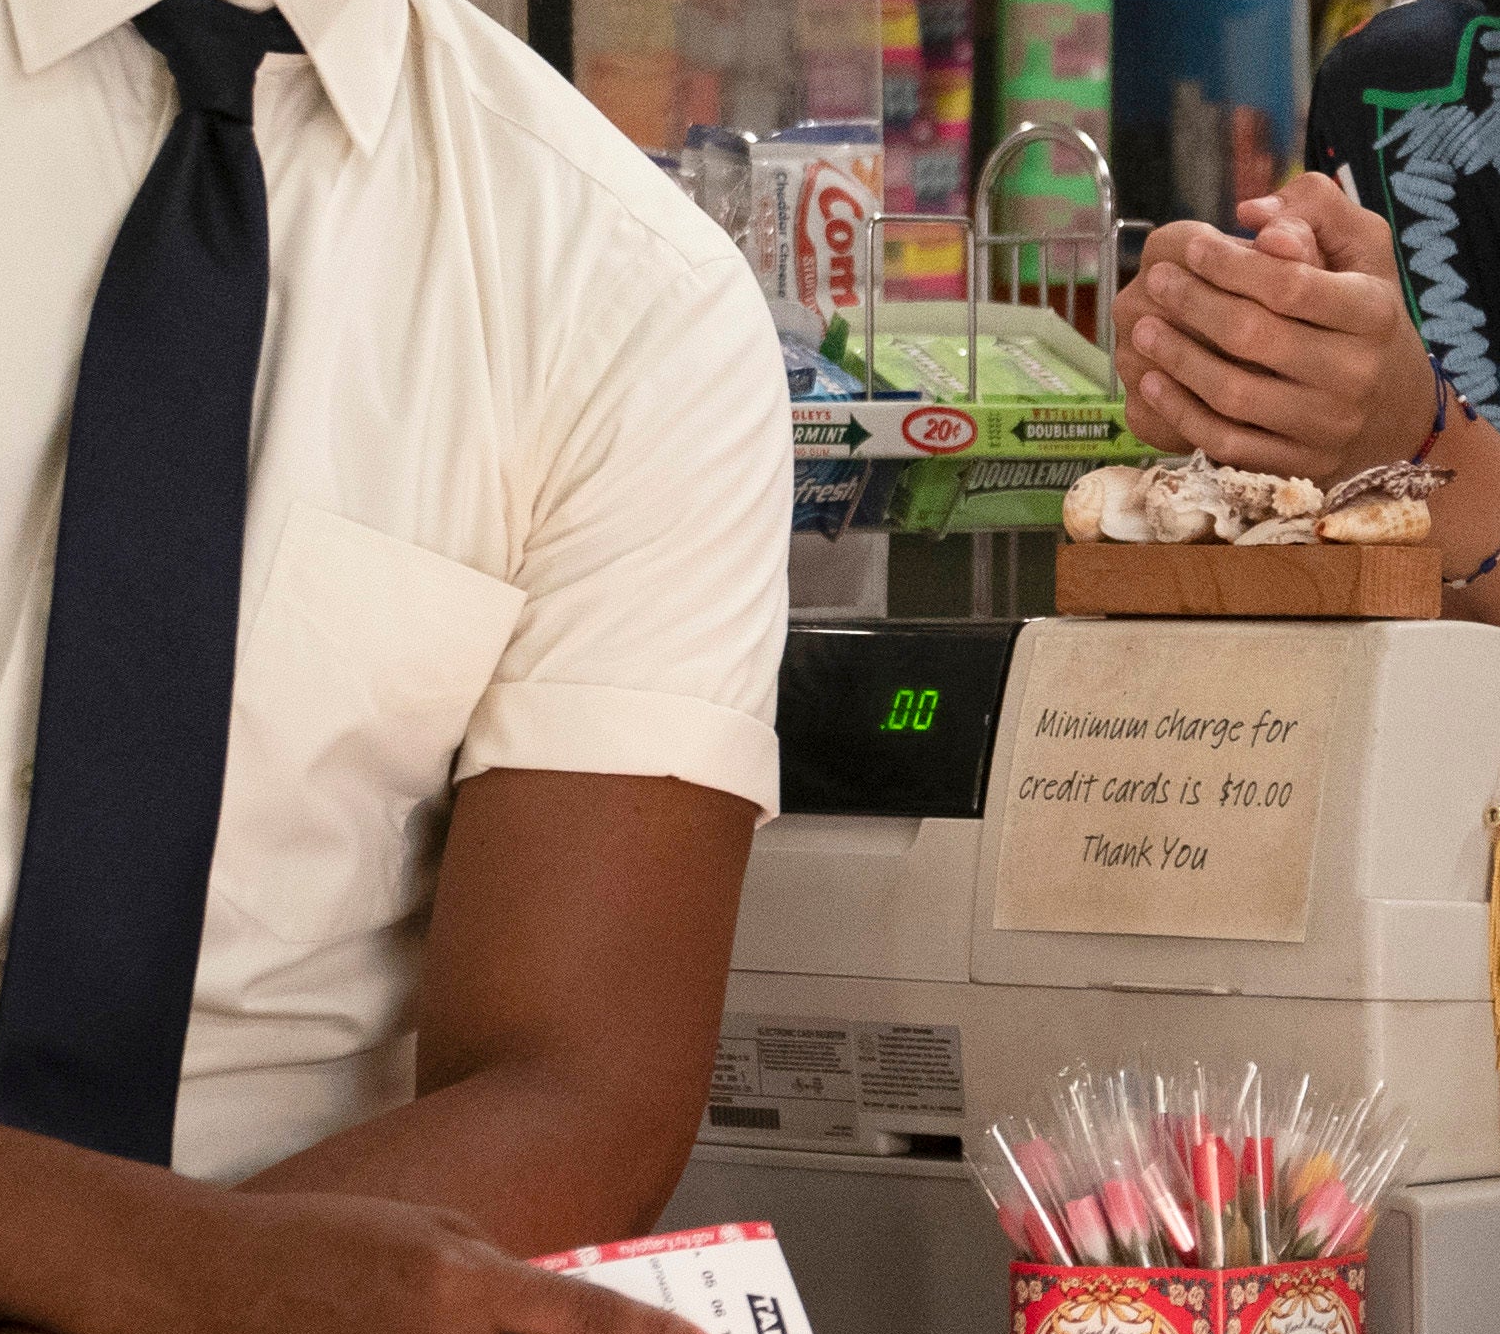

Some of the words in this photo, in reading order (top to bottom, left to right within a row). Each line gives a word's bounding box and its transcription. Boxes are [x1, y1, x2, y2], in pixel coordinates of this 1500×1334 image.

[920, 419, 964, 444] 20¢
[1025, 424, 1110, 442] DOUBLEMINT
[880, 688, 939, 732] .00
[1034, 707, 1150, 742] Minimum
[1154, 708, 1245, 750] charge
[1249, 708, 1300, 749] for
[1018, 769, 1100, 804] credit
[1102, 771, 1172, 806] cards
[1178, 775, 1202, 806] is
[1218, 772, 1294, 809] $10.00
[1081, 833, 1154, 869] Thank
[1158, 835, 1210, 871] You
